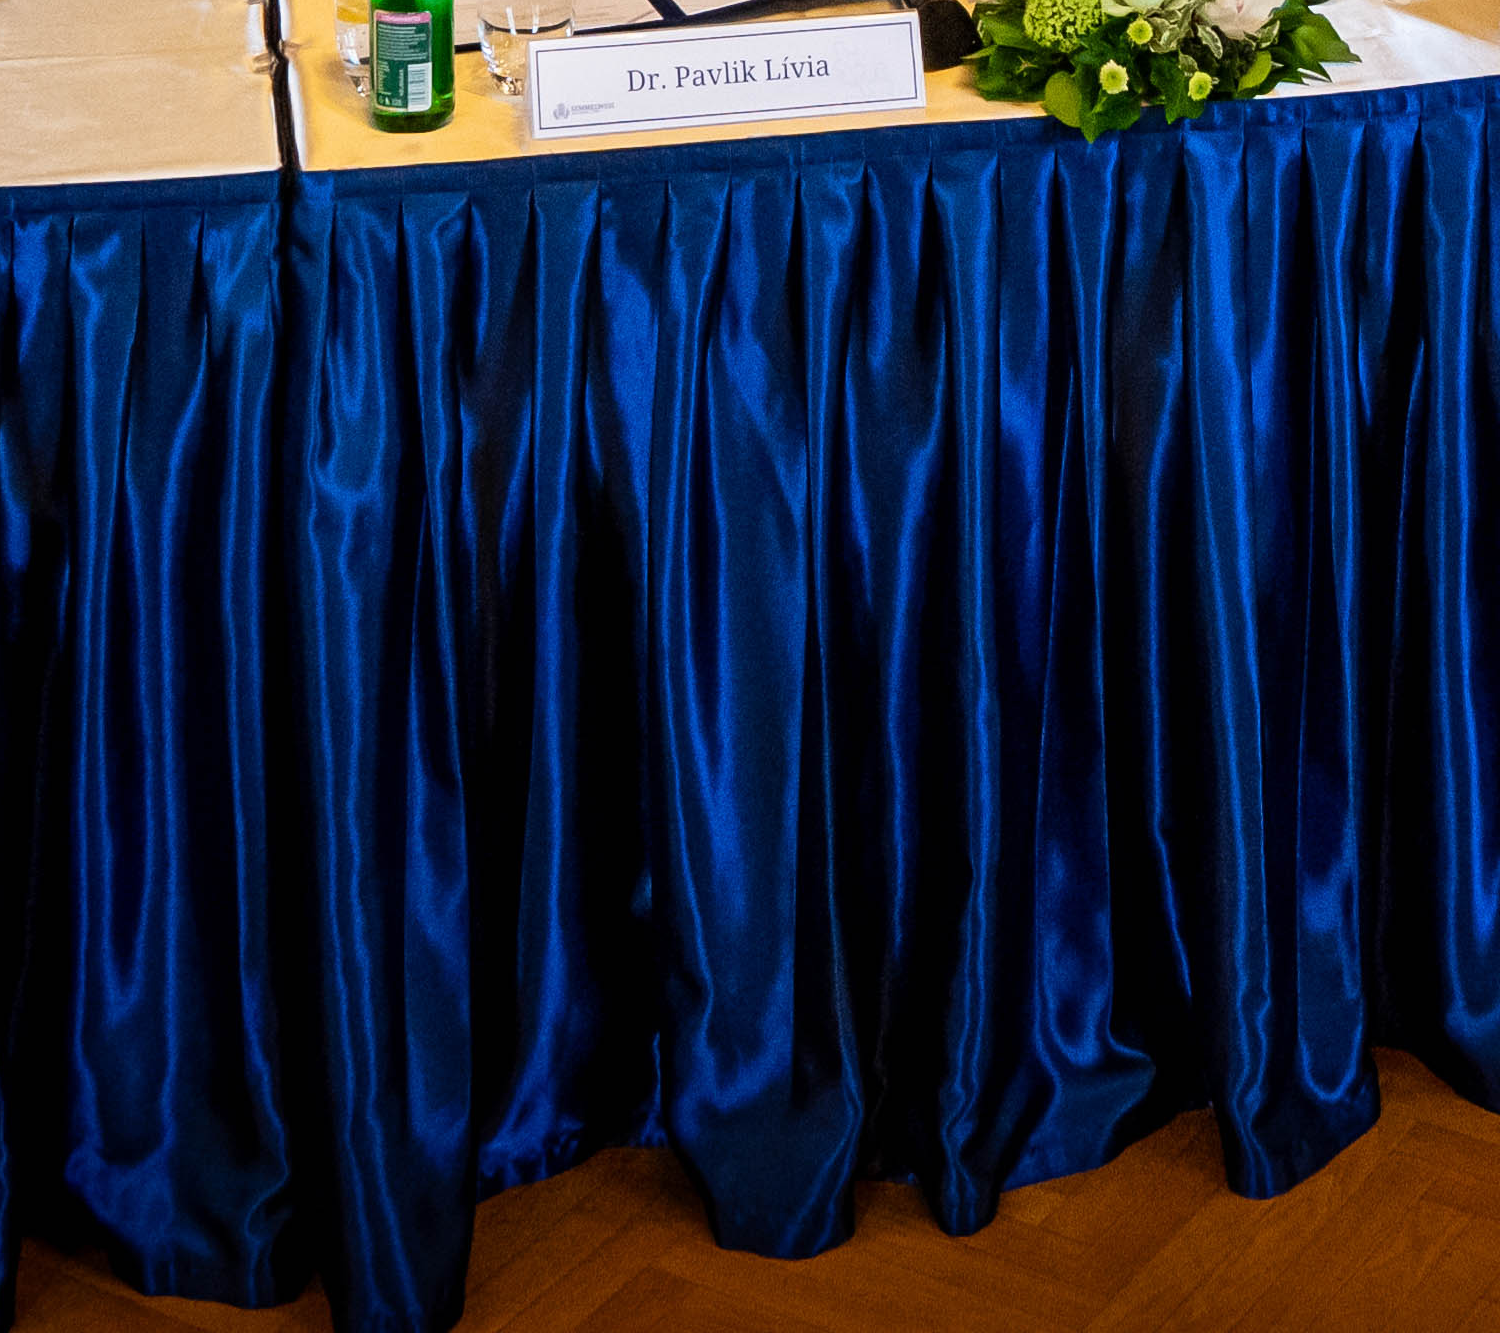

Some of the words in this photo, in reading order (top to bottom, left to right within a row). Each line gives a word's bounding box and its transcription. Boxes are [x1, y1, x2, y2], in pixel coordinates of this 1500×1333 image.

[626, 67, 668, 93] Dr.
[675, 59, 757, 90] Pavlik
[764, 54, 831, 84] Lívia
